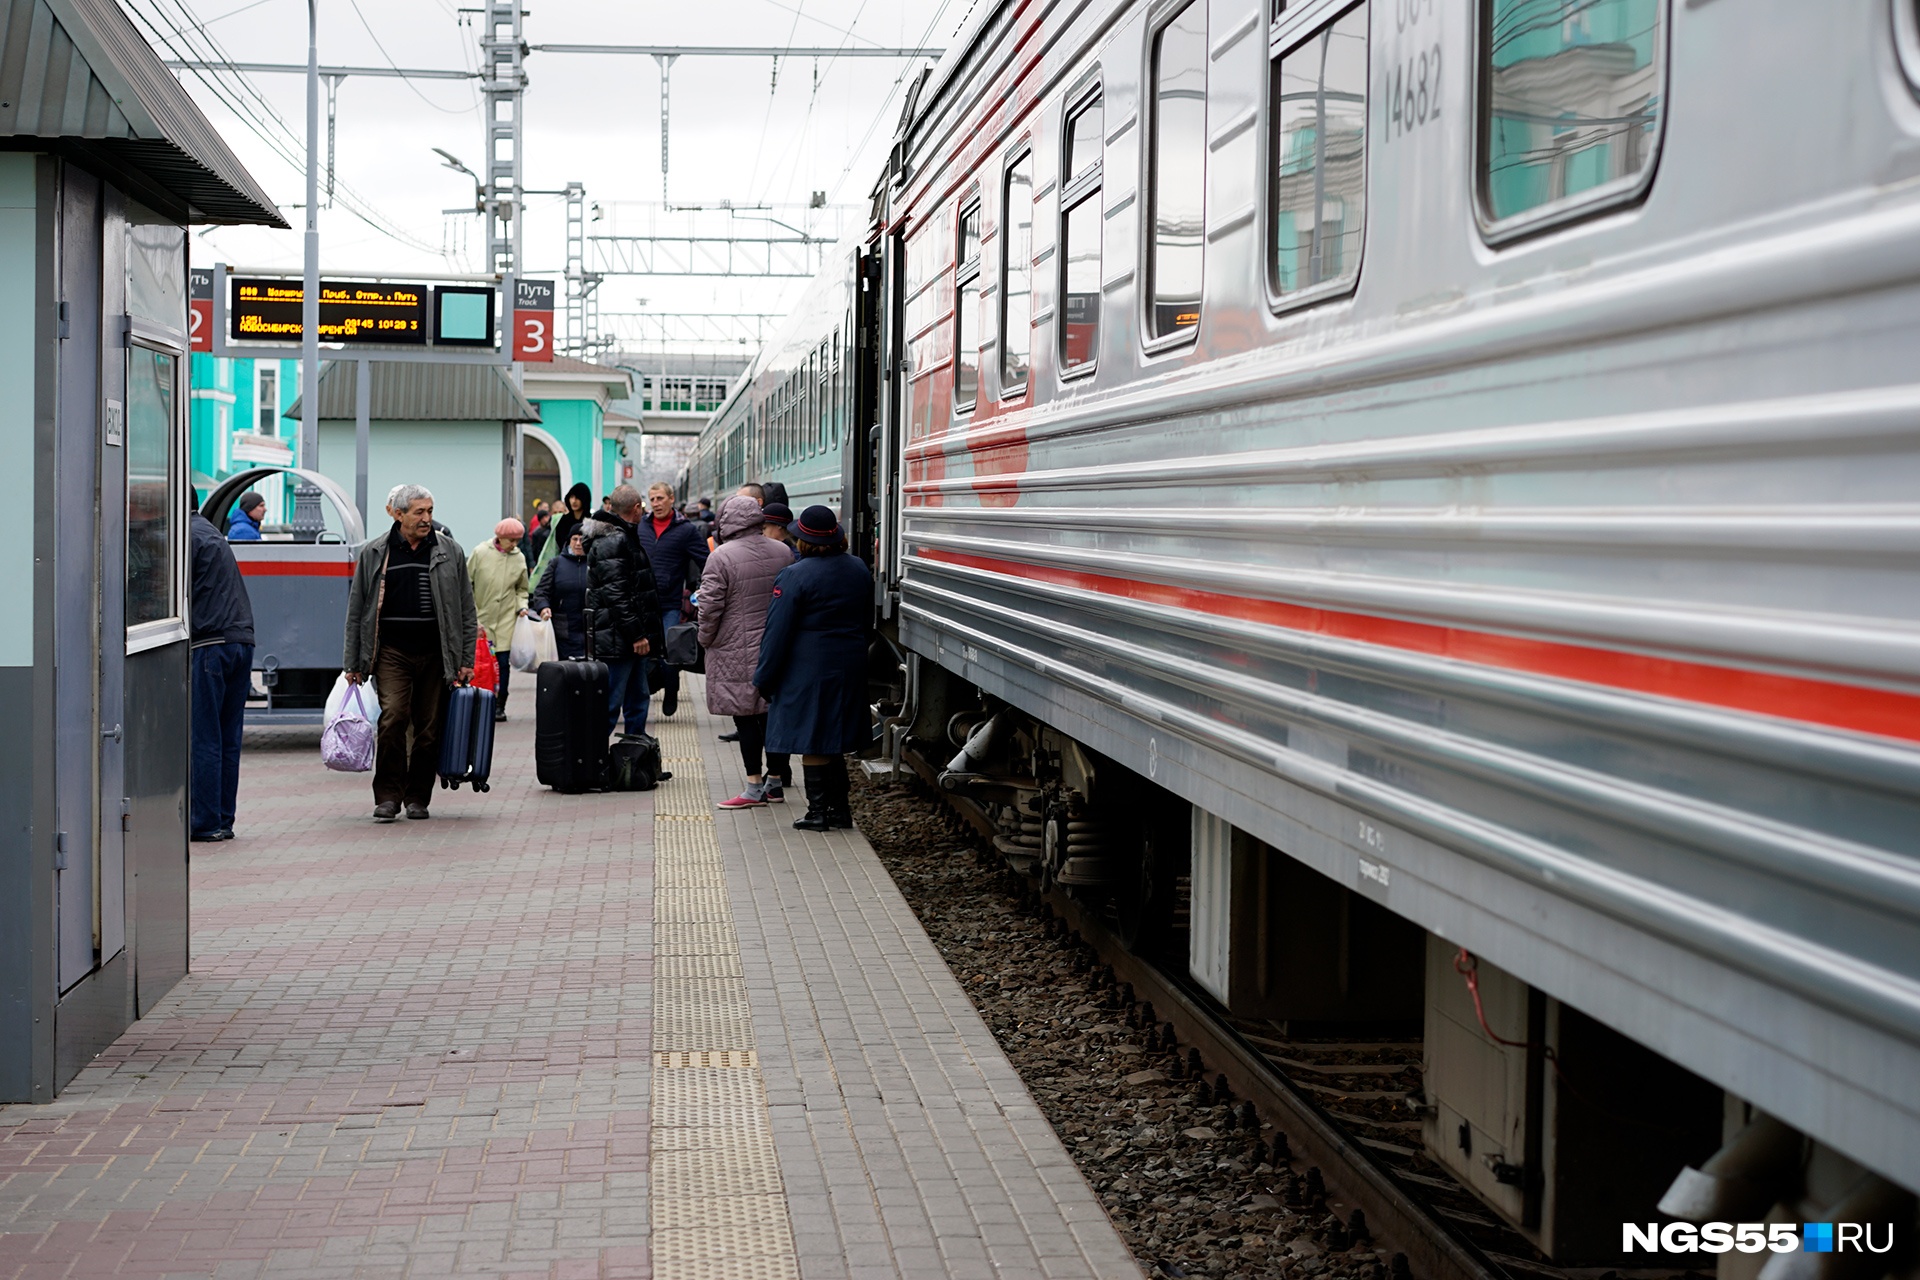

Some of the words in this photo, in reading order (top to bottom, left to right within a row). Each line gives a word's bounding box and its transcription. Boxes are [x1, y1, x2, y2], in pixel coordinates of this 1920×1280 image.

[1385, 42, 1442, 143] 14682
[518, 283, 551, 299] Путь
[518, 298, 538, 306] Track
[410, 320, 418, 330] 3
[522, 319, 545, 353] 3
